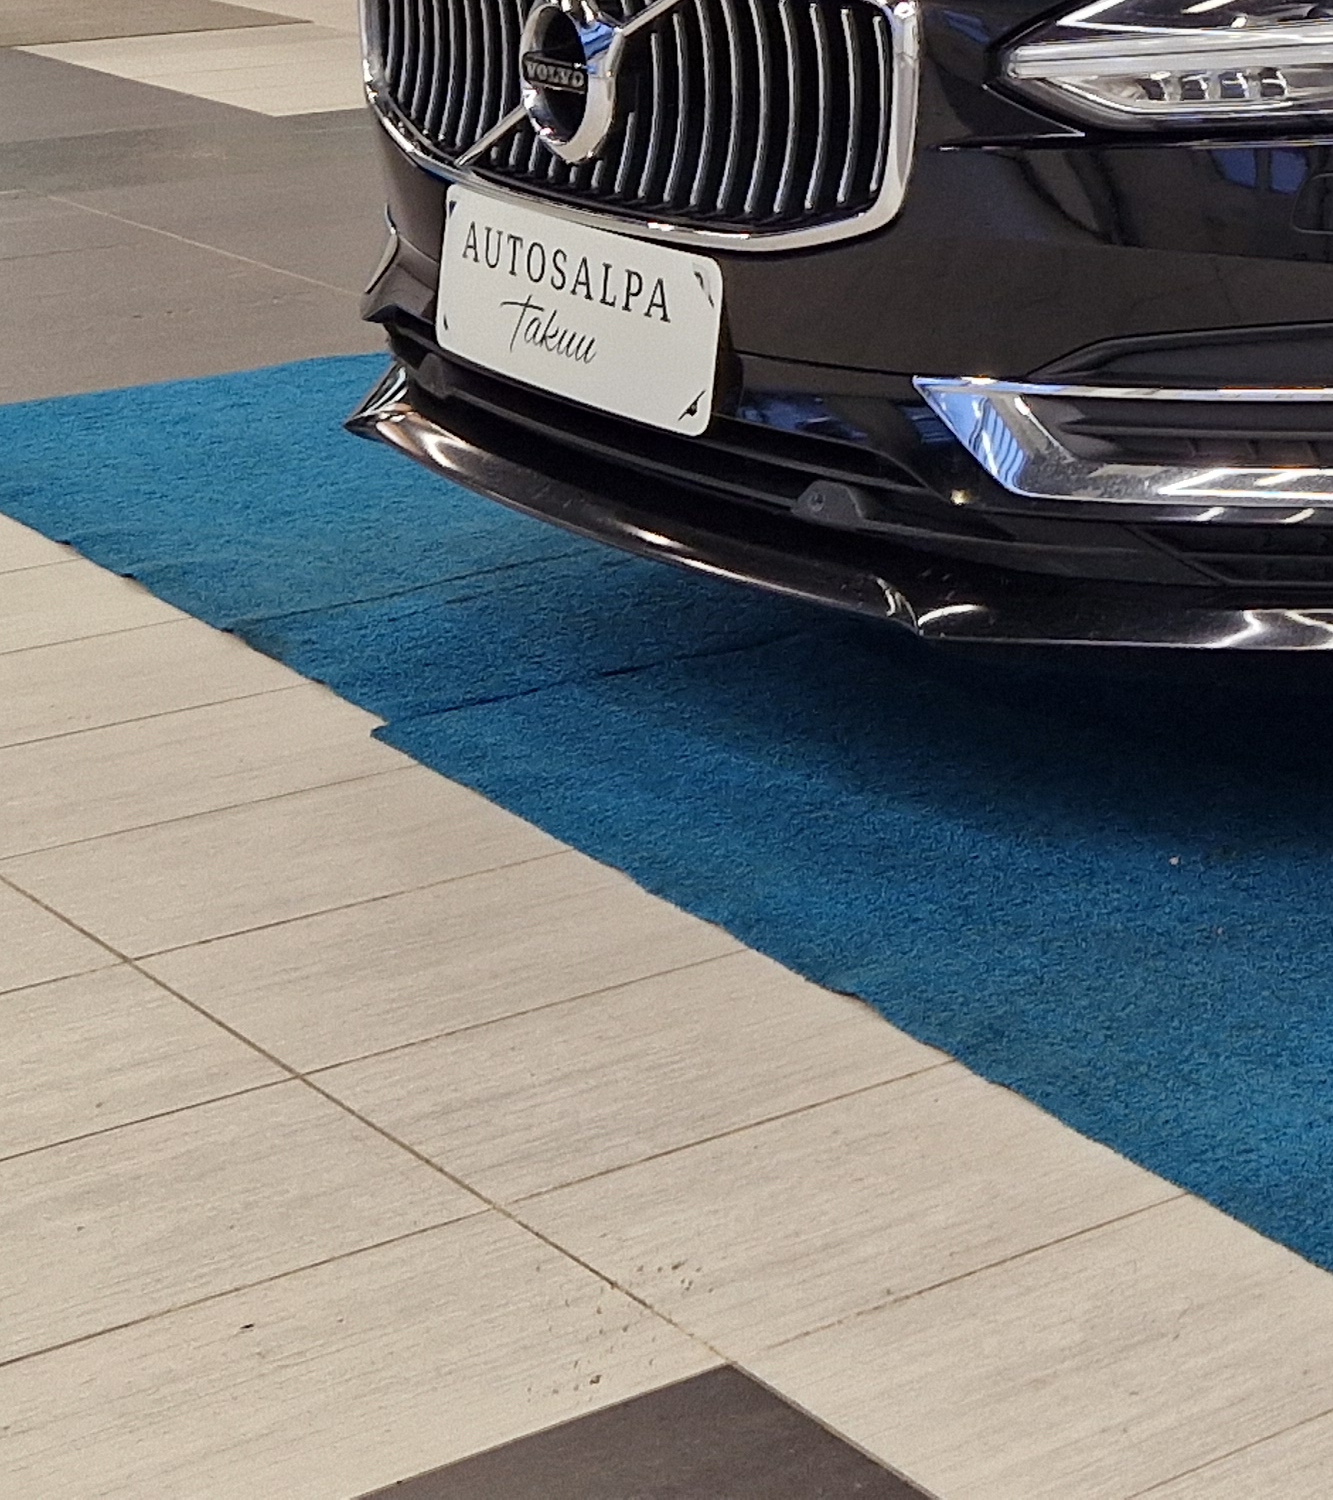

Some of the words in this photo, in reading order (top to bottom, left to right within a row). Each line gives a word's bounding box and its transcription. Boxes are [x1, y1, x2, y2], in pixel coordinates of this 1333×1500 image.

[526, 60, 584, 88] VOLVO
[462, 221, 671, 323] AUTOSALPA
[500, 295, 596, 363] Takuu
